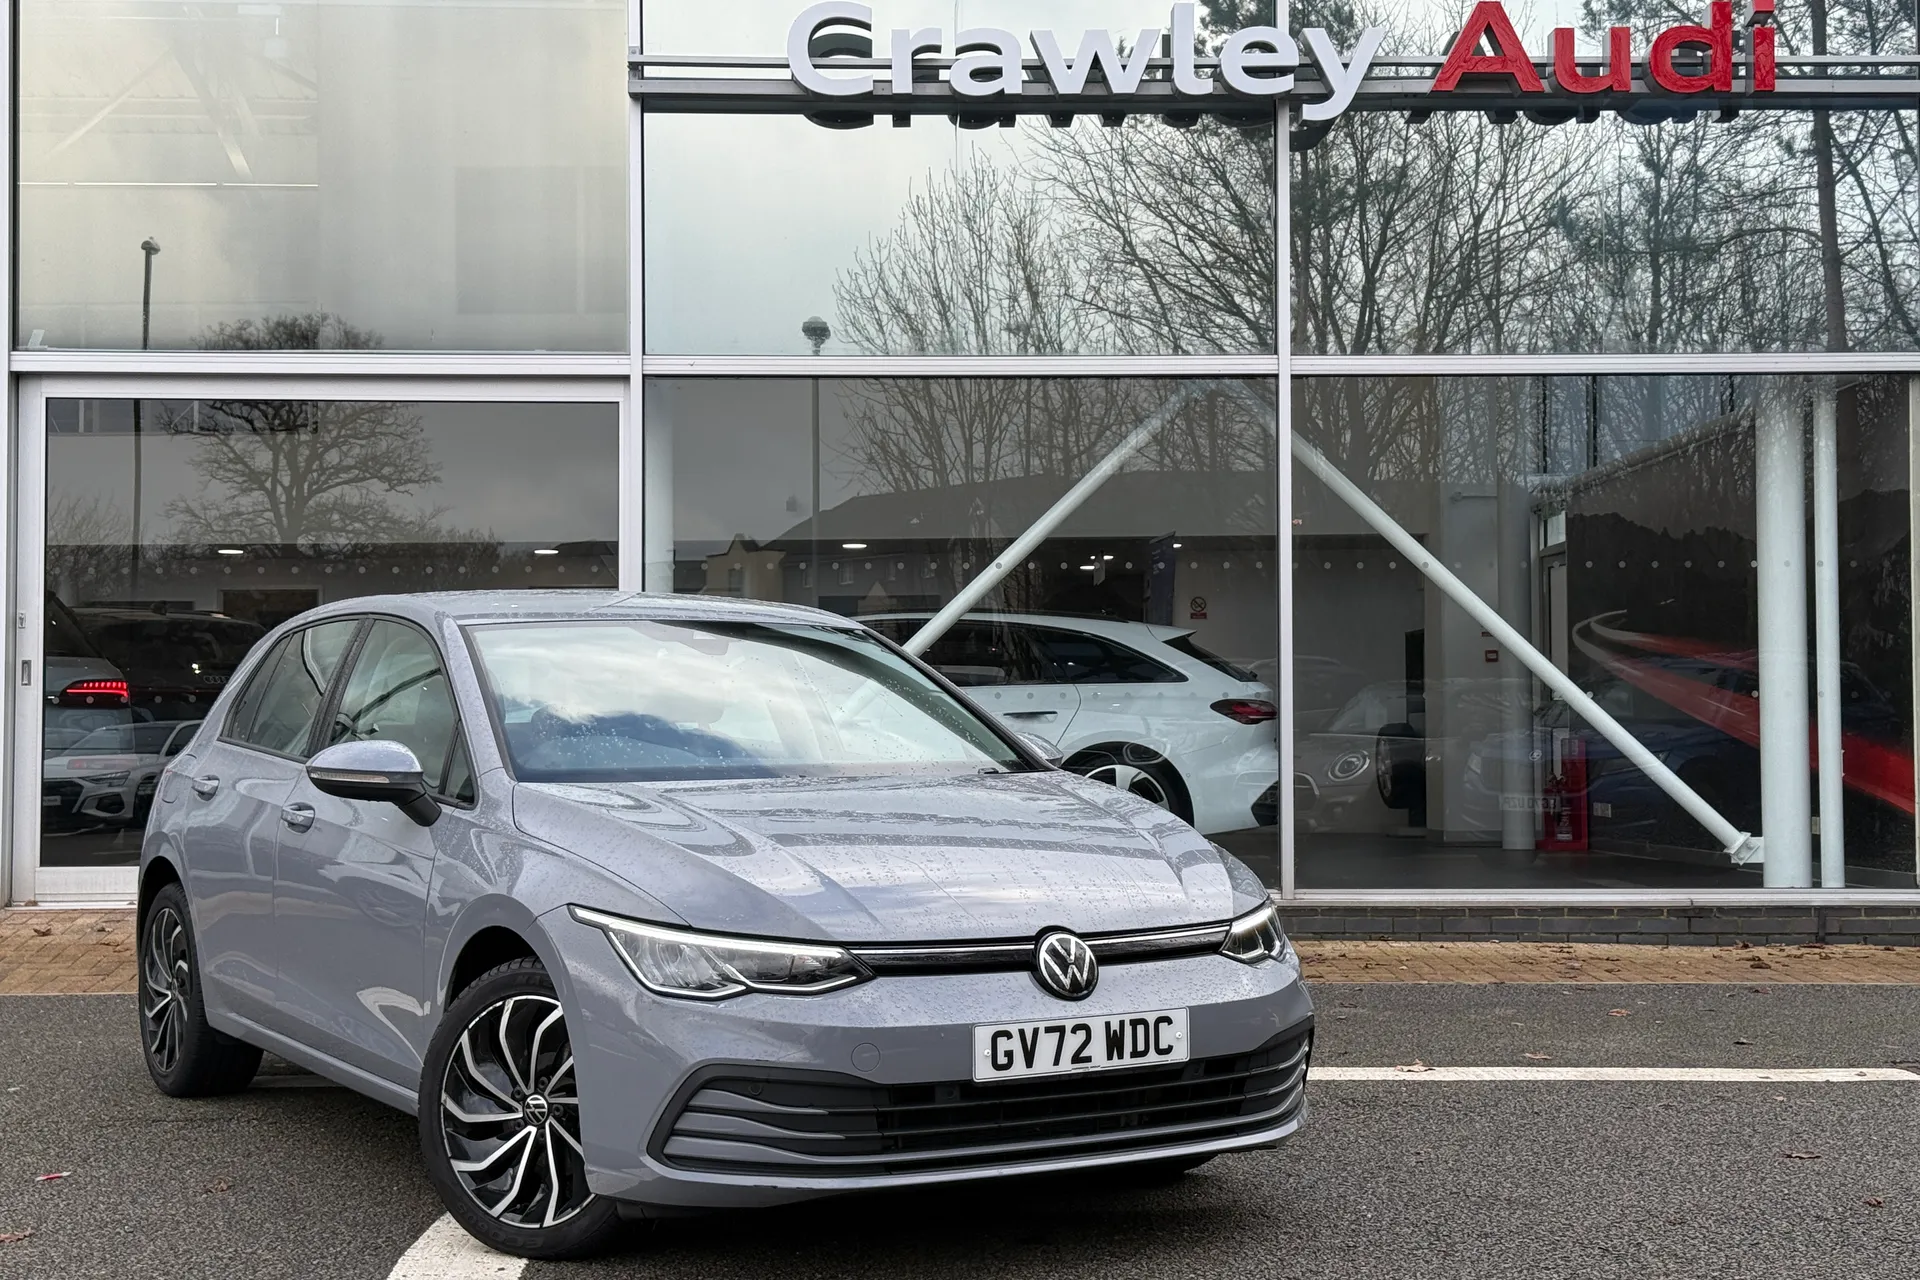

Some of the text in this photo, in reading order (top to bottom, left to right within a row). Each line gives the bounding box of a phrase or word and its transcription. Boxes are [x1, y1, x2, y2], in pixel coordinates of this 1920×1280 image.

[787, 0, 1776, 122] Crawley Audi
[990, 1015, 1174, 1072] GV72 WDC
